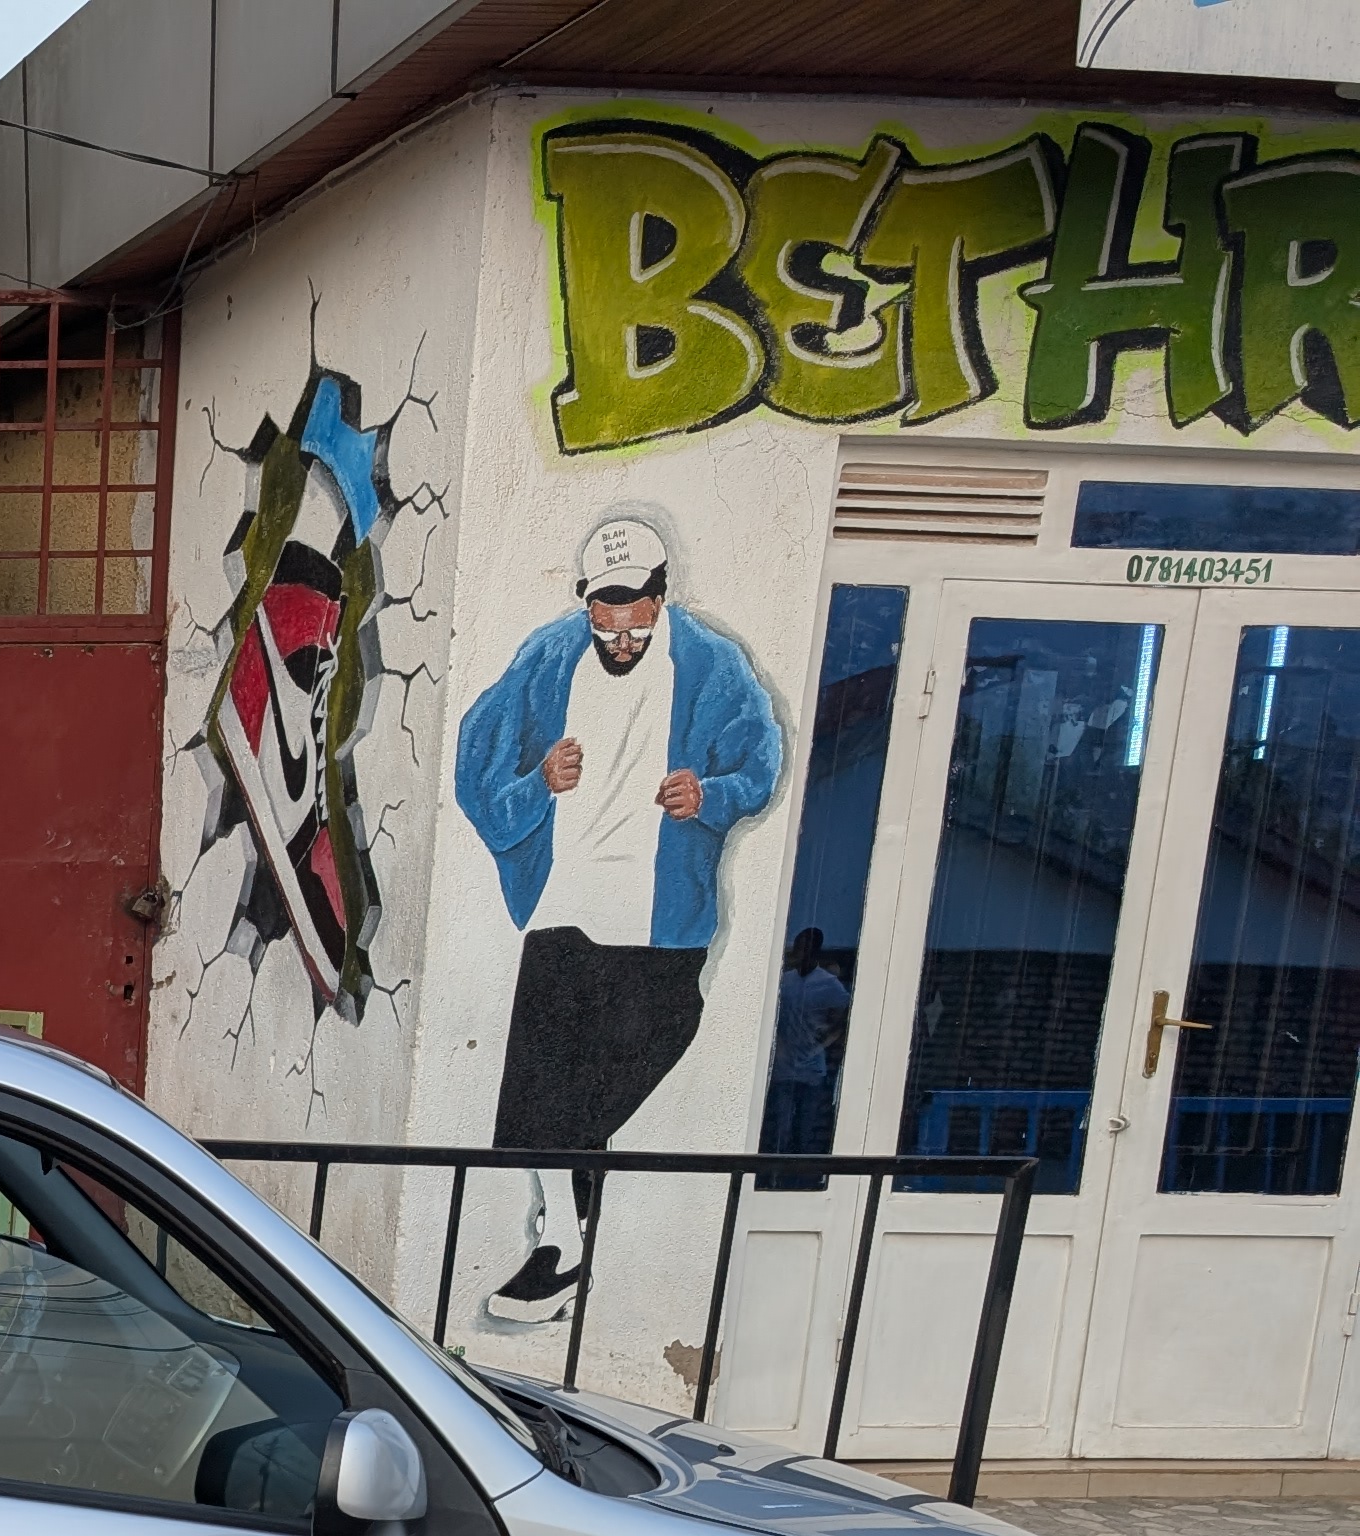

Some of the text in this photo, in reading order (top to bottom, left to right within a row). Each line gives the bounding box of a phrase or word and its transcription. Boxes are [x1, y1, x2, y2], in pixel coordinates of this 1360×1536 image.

[602, 529, 625, 541] BLAH
[604, 540, 627, 552] BLAH
[606, 552, 630, 566] BLAH
[1126, 554, 1273, 585] 0781403451
